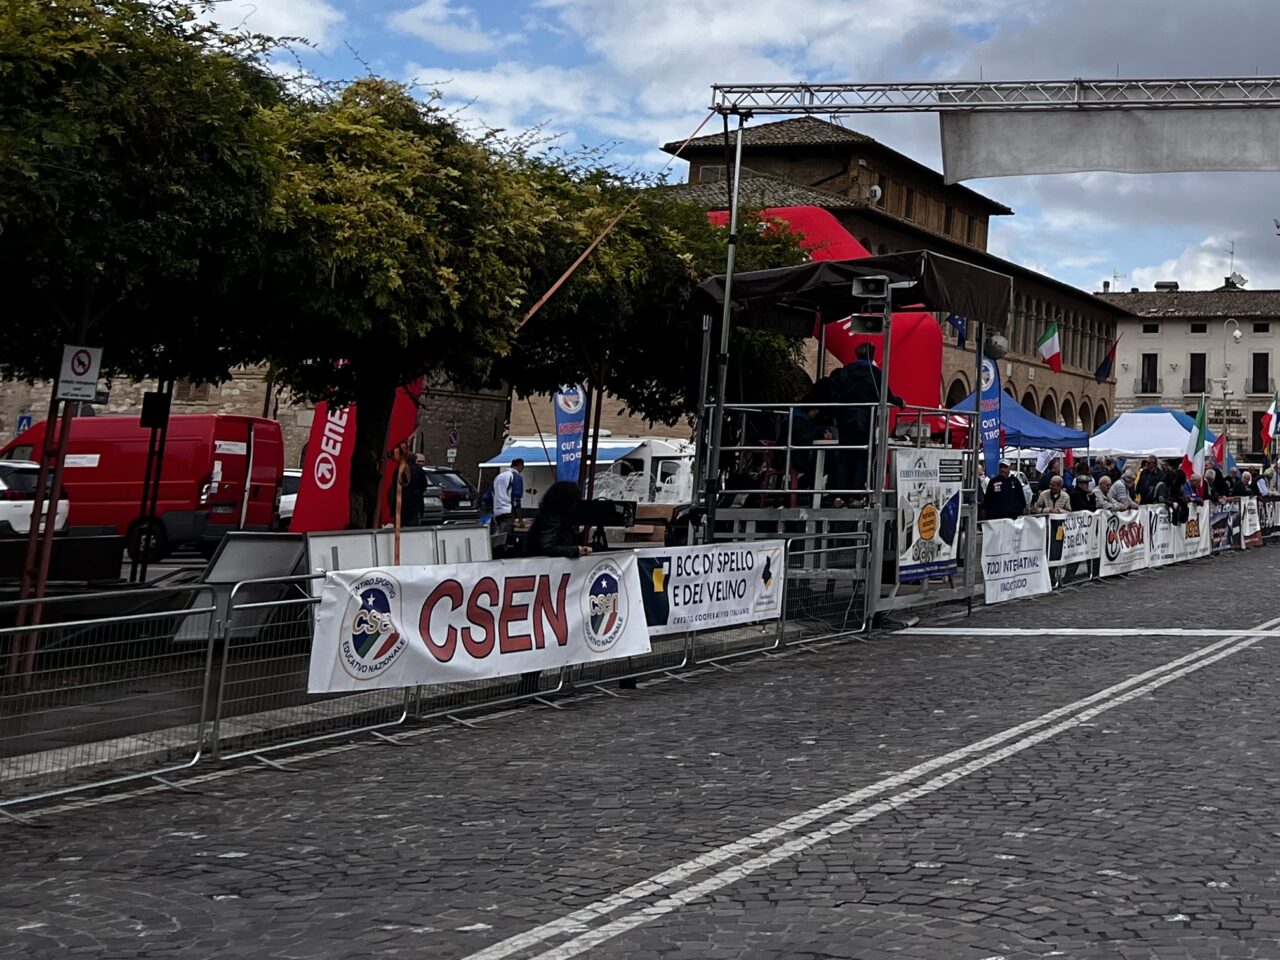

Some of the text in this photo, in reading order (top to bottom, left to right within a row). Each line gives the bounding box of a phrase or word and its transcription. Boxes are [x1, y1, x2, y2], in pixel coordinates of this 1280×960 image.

[676, 550, 754, 577] BCC DI SPELLO
[374, 577, 396, 599] SPORTIVO
[673, 585, 680, 607] E
[683, 583, 703, 606] DEL
[707, 578, 747, 602] VELINO
[418, 572, 571, 663] CSEN
[342, 638, 405, 673] EDUCATIVO NAZIONALE
